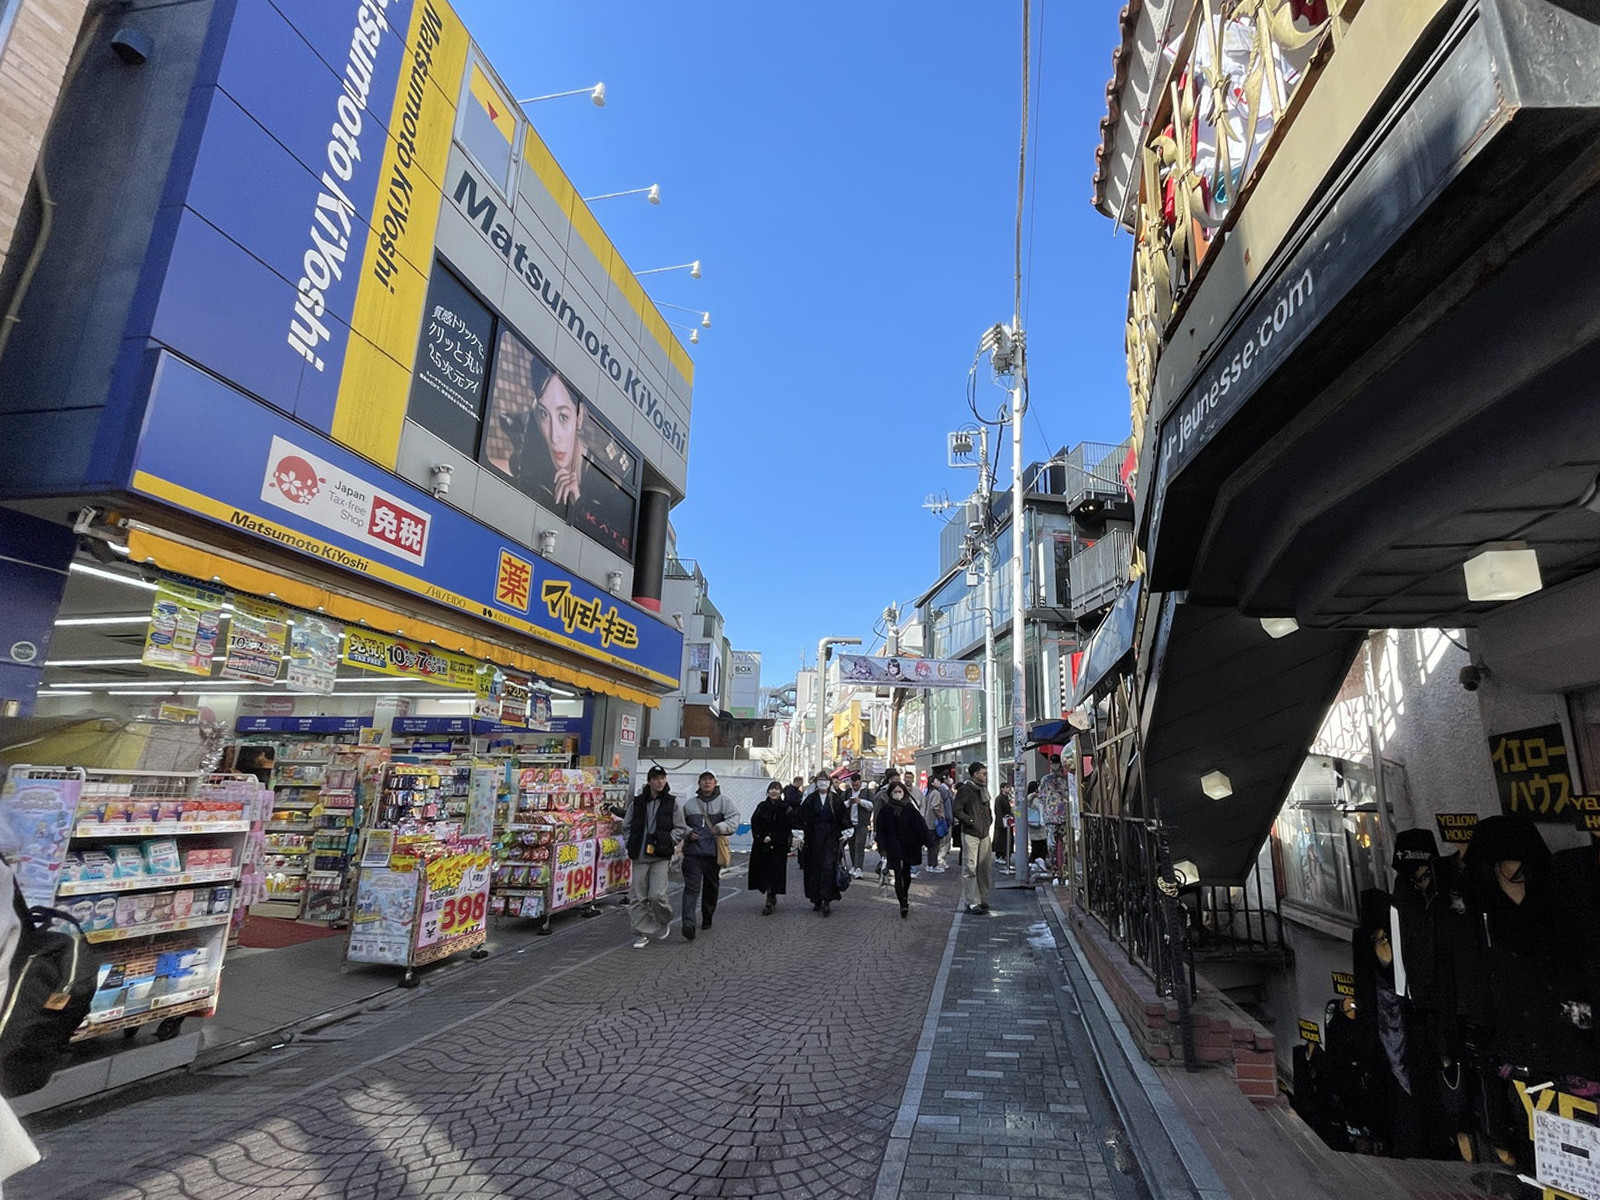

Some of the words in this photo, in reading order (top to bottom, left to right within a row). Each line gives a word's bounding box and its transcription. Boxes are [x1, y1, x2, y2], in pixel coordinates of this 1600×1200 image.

[397, 0, 443, 170] Matsumoto
[374, 164, 414, 295] KiYoshi
[287, 172, 356, 373] KiYoshi
[453, 169, 622, 383] Matsumoto
[623, 366, 687, 455] KiYoshi
[428, 321, 484, 375] クリッと丸い
[328, 491, 367, 517] Tax-free
[340, 508, 365, 528] Shop
[230, 510, 320, 555] Matsumoto
[321, 544, 369, 573] KiYoshi
[372, 504, 424, 553] 免税
[425, 585, 467, 609] SHISEIDO
[500, 556, 533, 608] 薬
[480, 683, 498, 695] SALE
[735, 665, 752, 673] BOX
[1492, 737, 1567, 774] イエロー
[1510, 772, 1571, 814] ハウス
[1436, 814, 1478, 827] YELLOW
[566, 866, 593, 896] 198
[441, 892, 486, 931] 398
